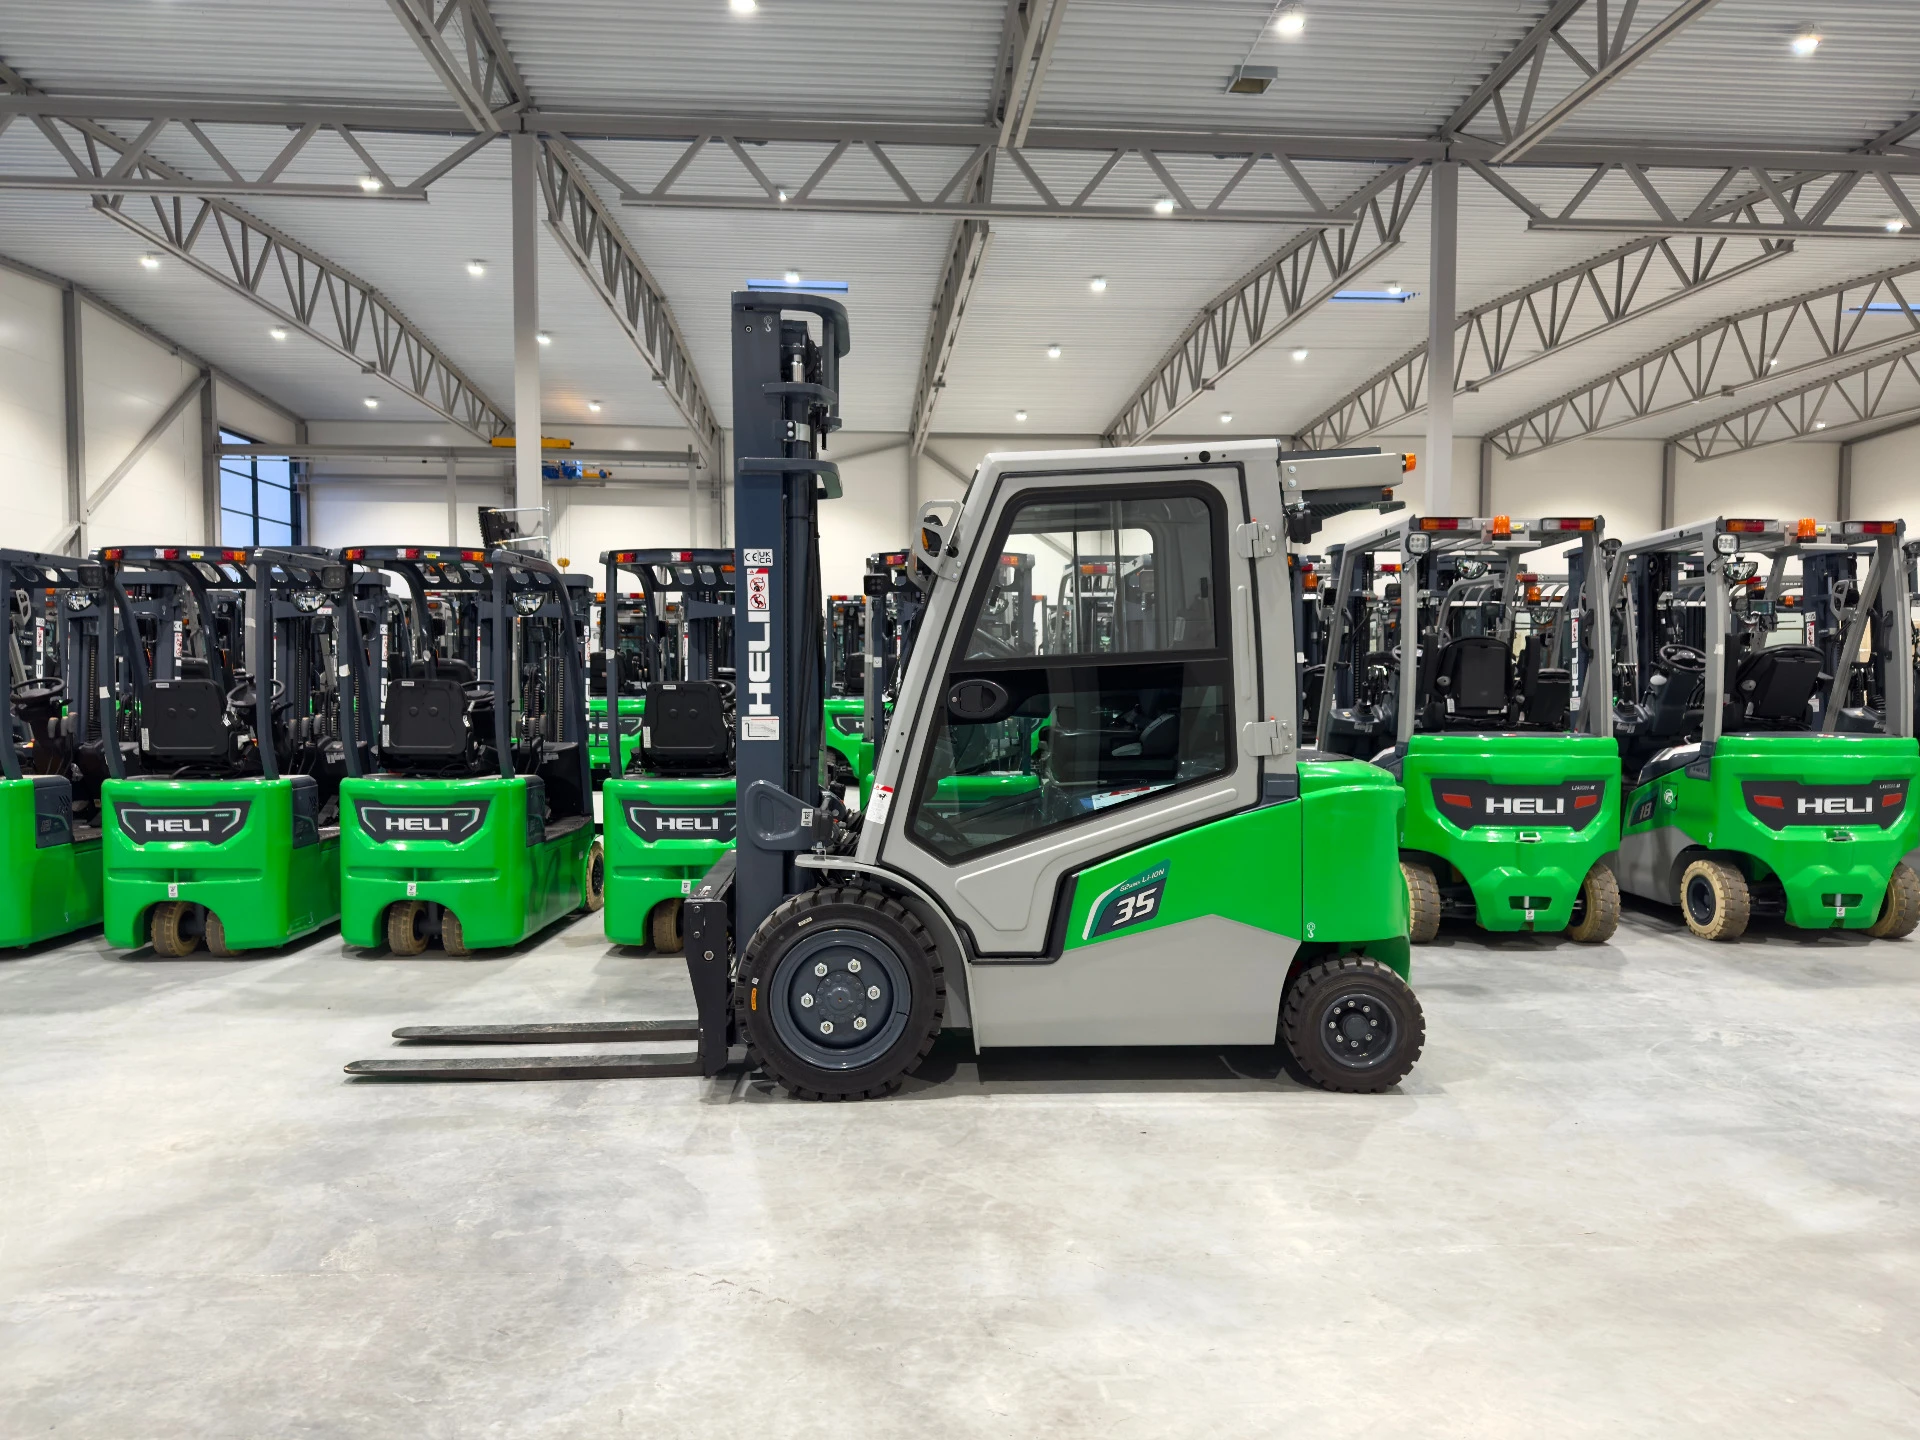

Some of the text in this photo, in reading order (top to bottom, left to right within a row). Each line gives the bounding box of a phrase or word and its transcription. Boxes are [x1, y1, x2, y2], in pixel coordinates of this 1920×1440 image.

[744, 552, 758, 562] CE
[748, 610, 771, 715] HELI
[1571, 641, 1579, 698] HELI
[1485, 797, 1566, 815] HELI
[1797, 797, 1873, 815] HELI
[145, 819, 210, 832] HELI
[385, 817, 449, 831] HELI
[655, 817, 719, 831] HELI
[1112, 887, 1157, 926] 35
